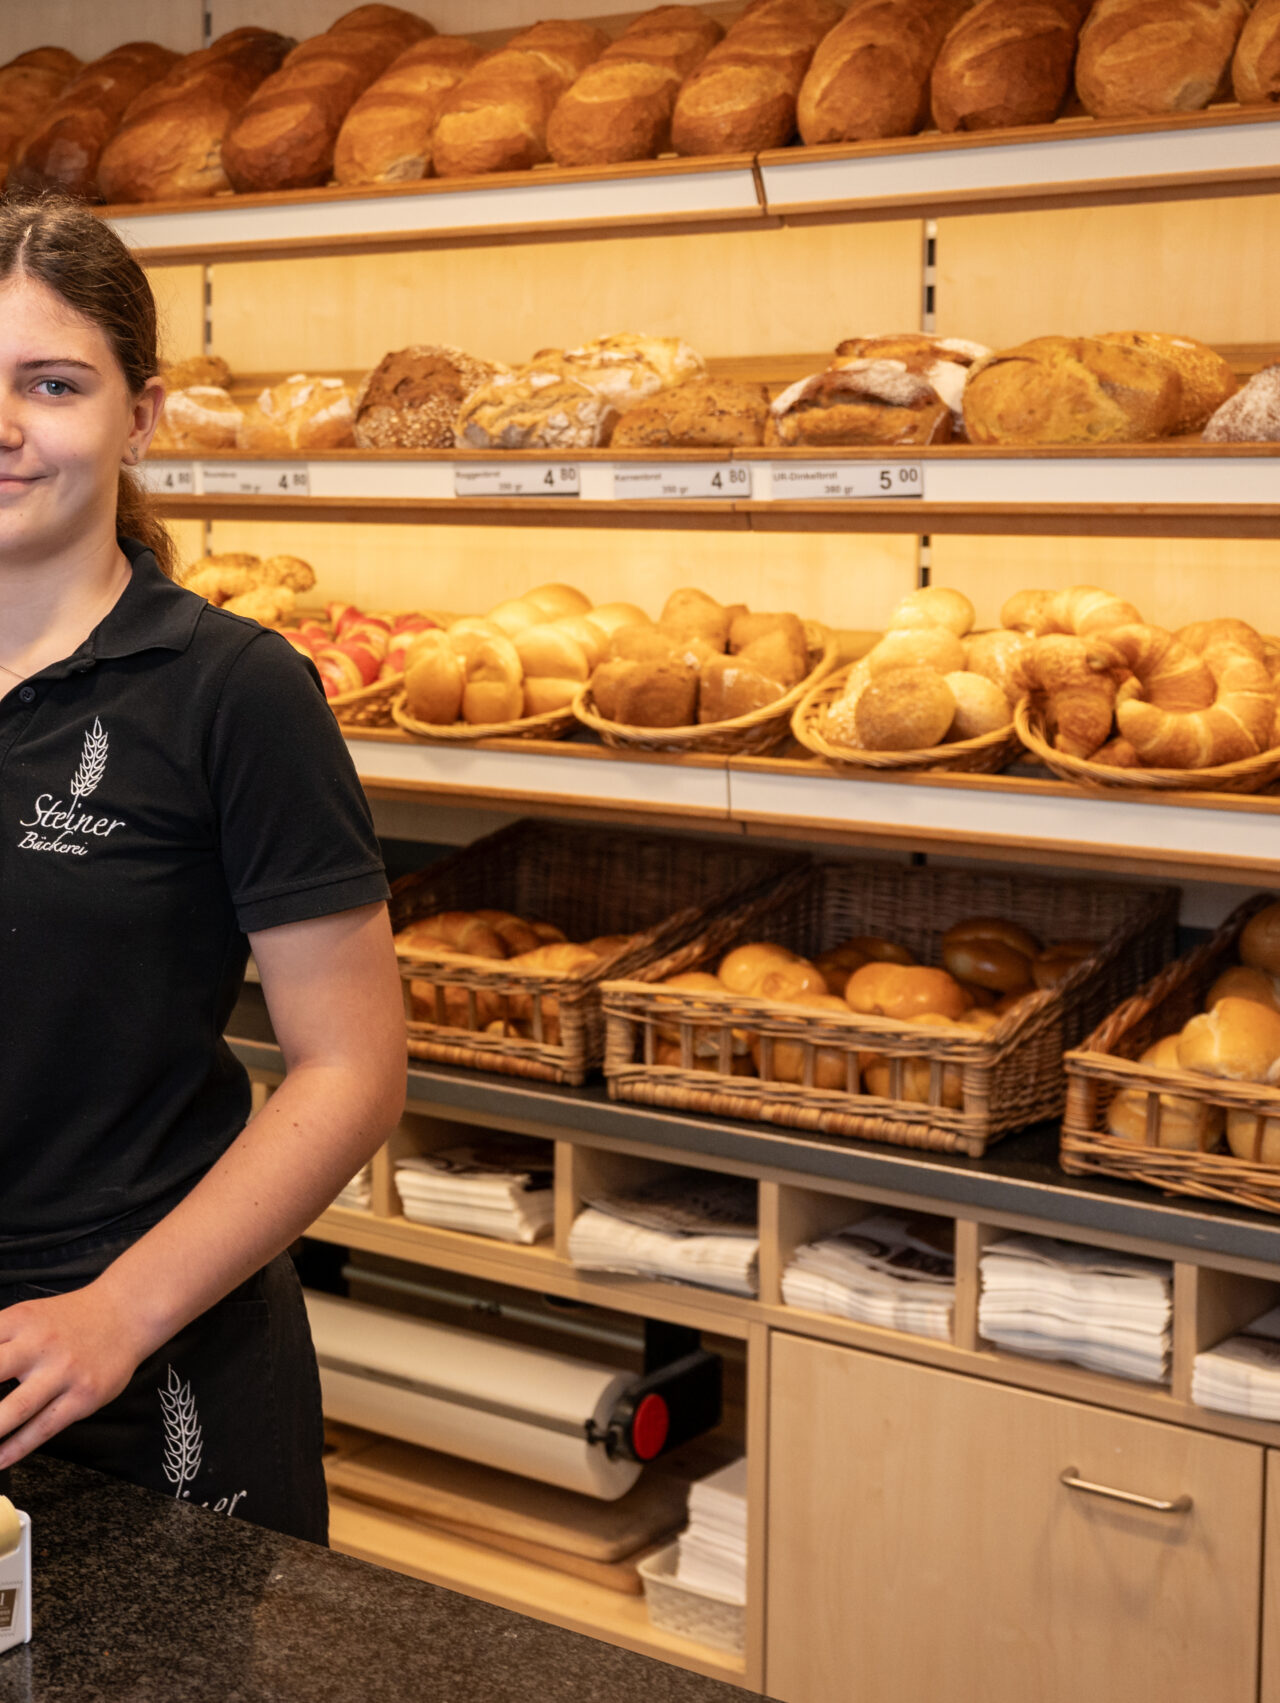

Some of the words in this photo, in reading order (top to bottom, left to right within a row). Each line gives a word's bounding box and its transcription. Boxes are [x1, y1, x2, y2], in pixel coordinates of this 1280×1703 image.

[165, 472, 173, 487] 4
[279, 474, 288, 489] 4
[544, 469, 554, 486] 4
[560, 467, 576, 480] 80
[711, 471, 723, 490] 4
[729, 469, 746, 483] 80
[880, 470, 892, 489] 5
[899, 468, 918, 482] 00
[20, 794, 126, 837] Steiner
[18, 831, 89, 855] Bäckerei
